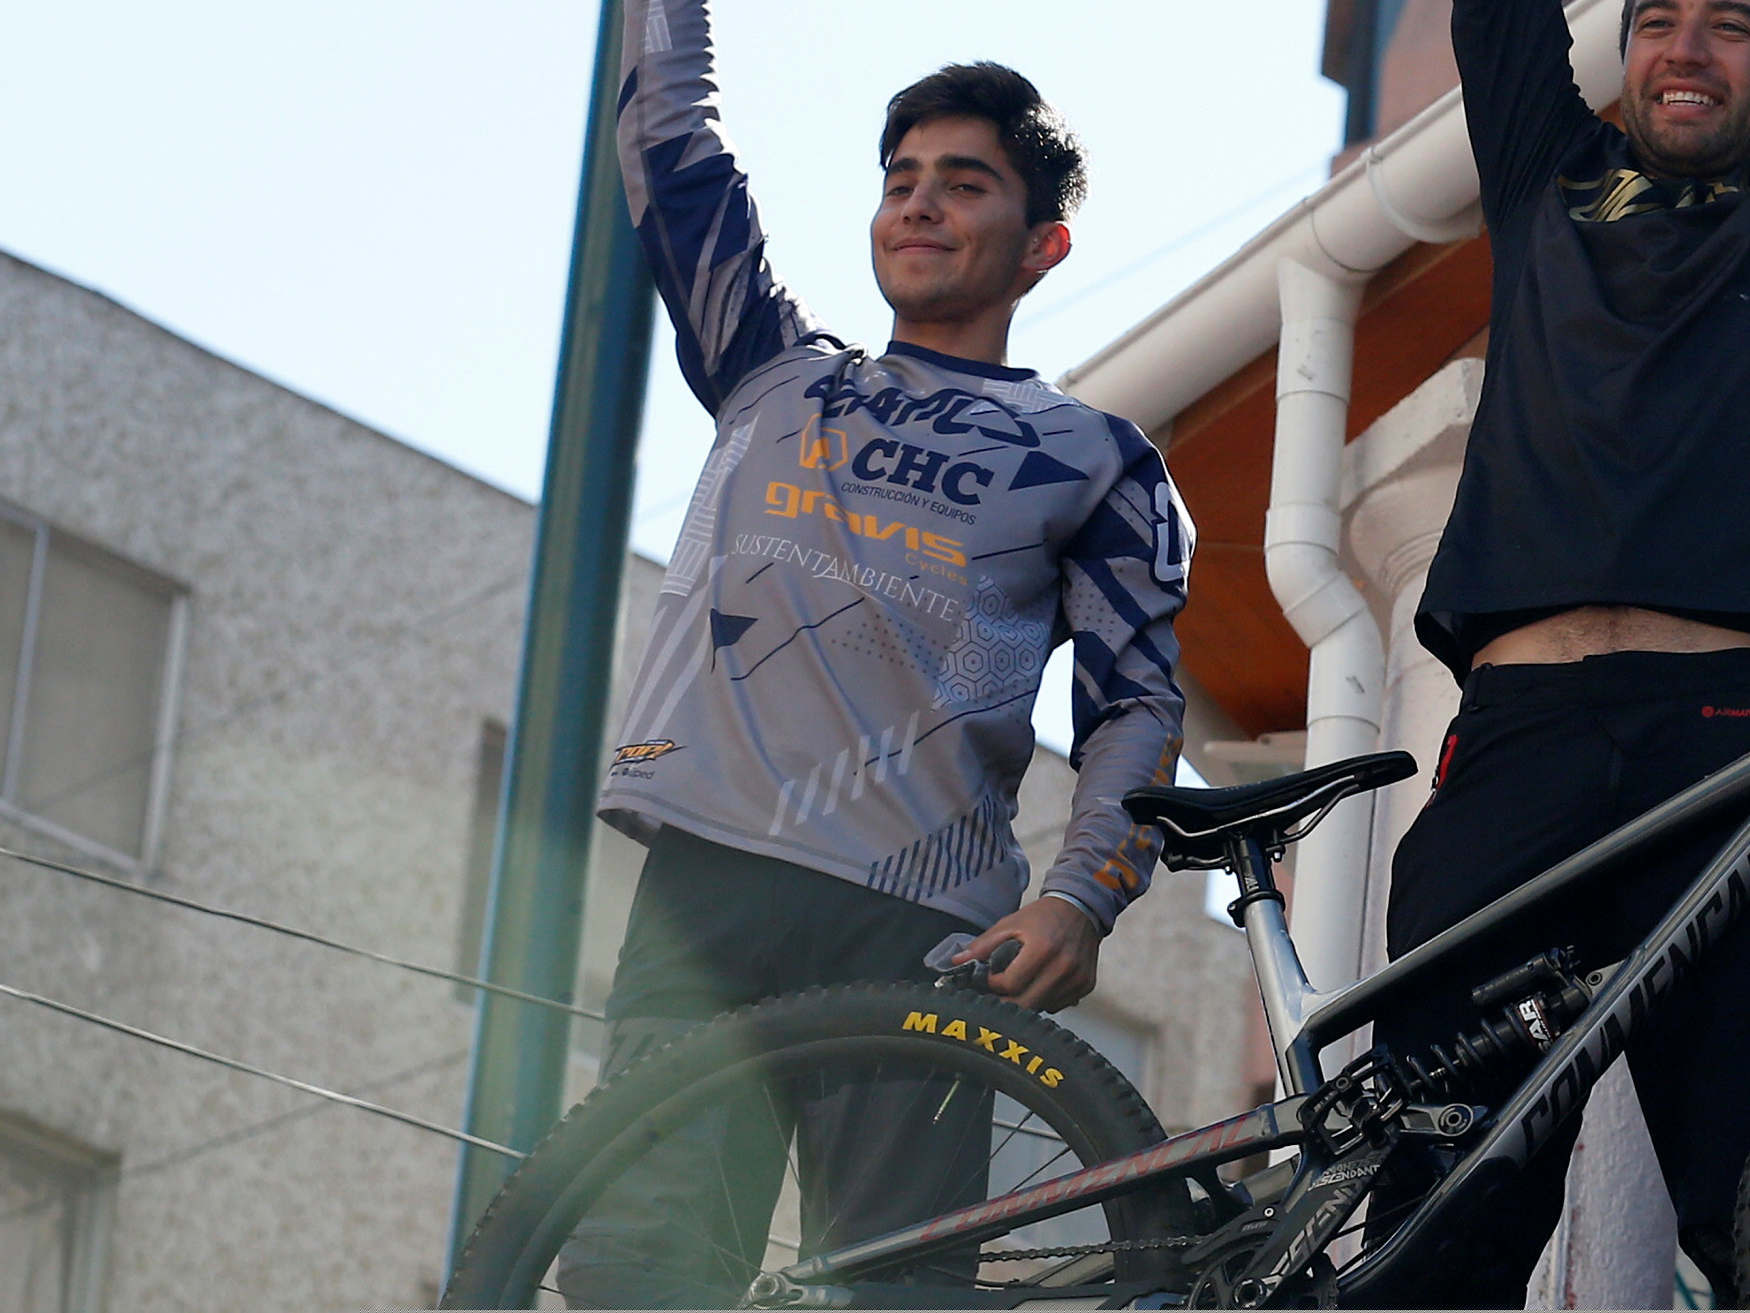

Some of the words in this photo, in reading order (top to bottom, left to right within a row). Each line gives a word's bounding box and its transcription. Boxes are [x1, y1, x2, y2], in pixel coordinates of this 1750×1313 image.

[841, 482, 920, 507] CONSTRUCCIÓN
[920, 497, 930, 509] Y
[930, 500, 977, 526] EQUIPOS
[851, 437, 995, 506] CHC
[764, 481, 968, 568] gravis
[731, 534, 959, 622] SUSTENTAMBIENTE
[902, 1010, 1067, 1089] MAXXIS
